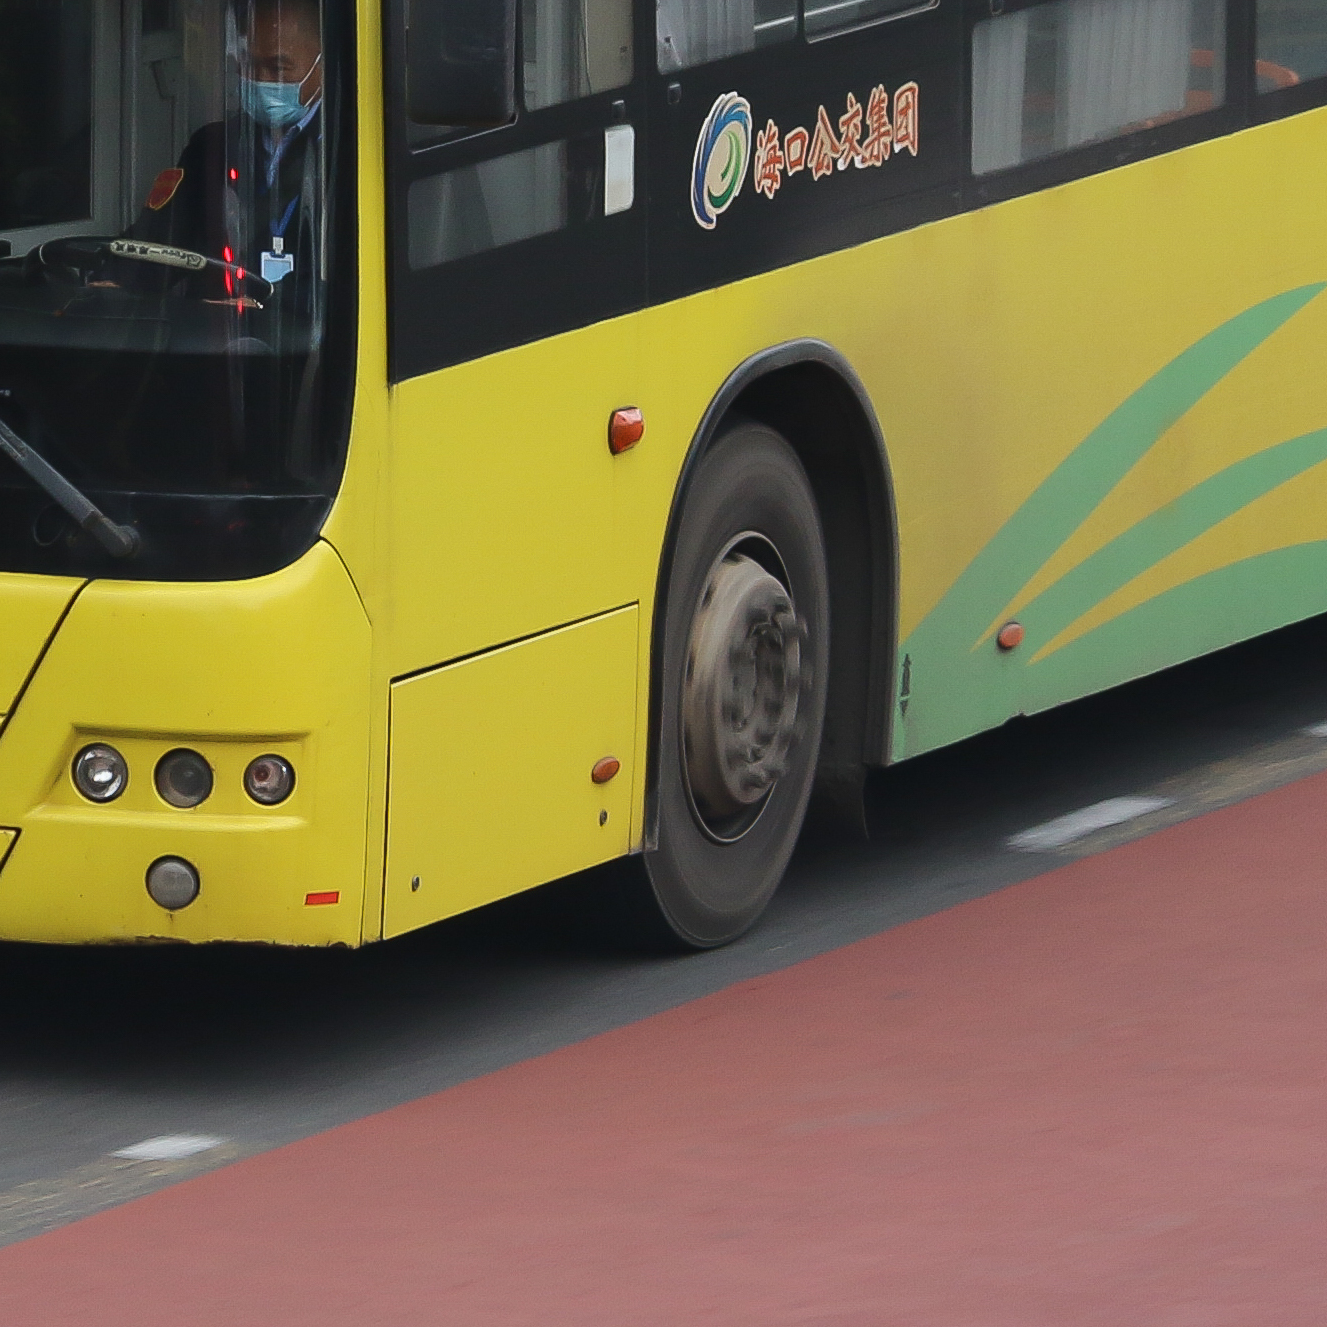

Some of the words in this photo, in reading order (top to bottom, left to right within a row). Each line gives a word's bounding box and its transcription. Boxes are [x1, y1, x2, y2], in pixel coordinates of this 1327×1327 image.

[754, 82, 919, 199] 海口公交集团
